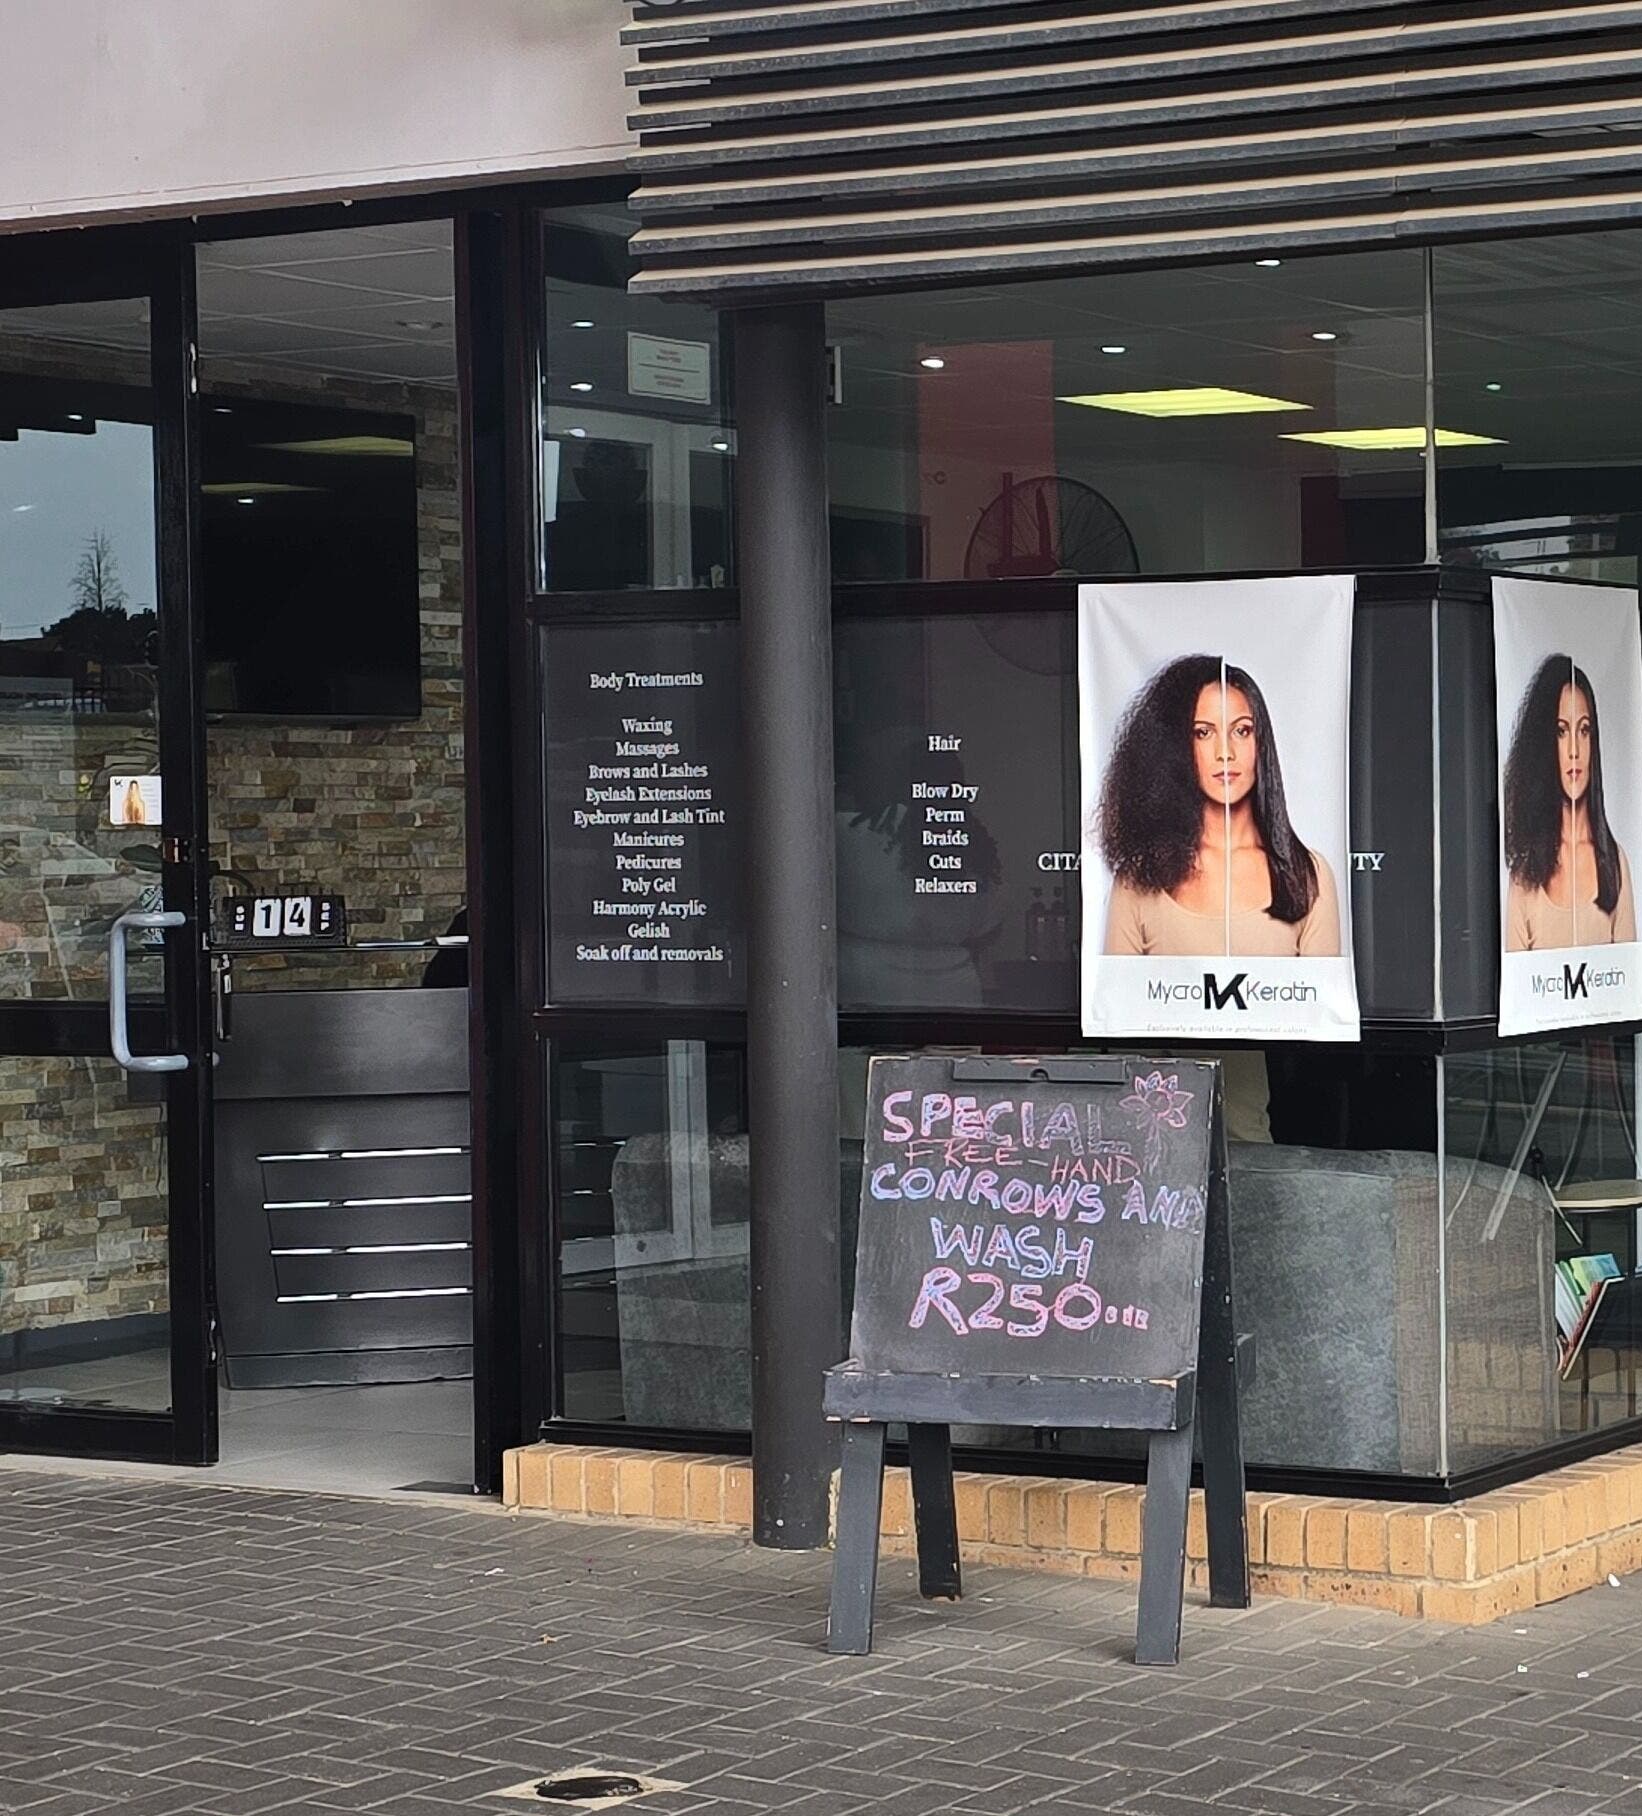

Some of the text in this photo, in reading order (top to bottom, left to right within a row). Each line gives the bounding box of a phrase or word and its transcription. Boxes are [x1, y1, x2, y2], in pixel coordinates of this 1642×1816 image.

[590, 671, 703, 692] Body Treatments
[622, 716, 673, 735] Waxing
[616, 742, 680, 759] Massages
[928, 735, 961, 751] Hair
[589, 763, 708, 779] Brows and Lashes
[586, 786, 712, 806] Eyelash Extensions
[912, 782, 979, 802] Blow Dry
[573, 808, 725, 829] Eyebrow and Lash Tint
[926, 807, 965, 823] Perm
[613, 832, 684, 847] Manicures
[922, 829, 969, 846] Braids
[615, 854, 682, 870] Pedicures
[929, 854, 962, 870] Cuts
[622, 877, 676, 895] Poly Gel
[915, 877, 977, 893] Relaxers
[593, 899, 706, 919] Harmony Acrylic
[628, 923, 670, 938] Gelish
[576, 945, 723, 961] Soak off and removals
[1586, 967, 1625, 988] Keratin
[1147, 980, 1202, 1005] Mycro
[1247, 980, 1317, 1002] Keratin
[883, 1090, 1132, 1156] SPECIAL
[870, 1163, 1106, 1224] CONROWS
[930, 1217, 1093, 1282] WASH
